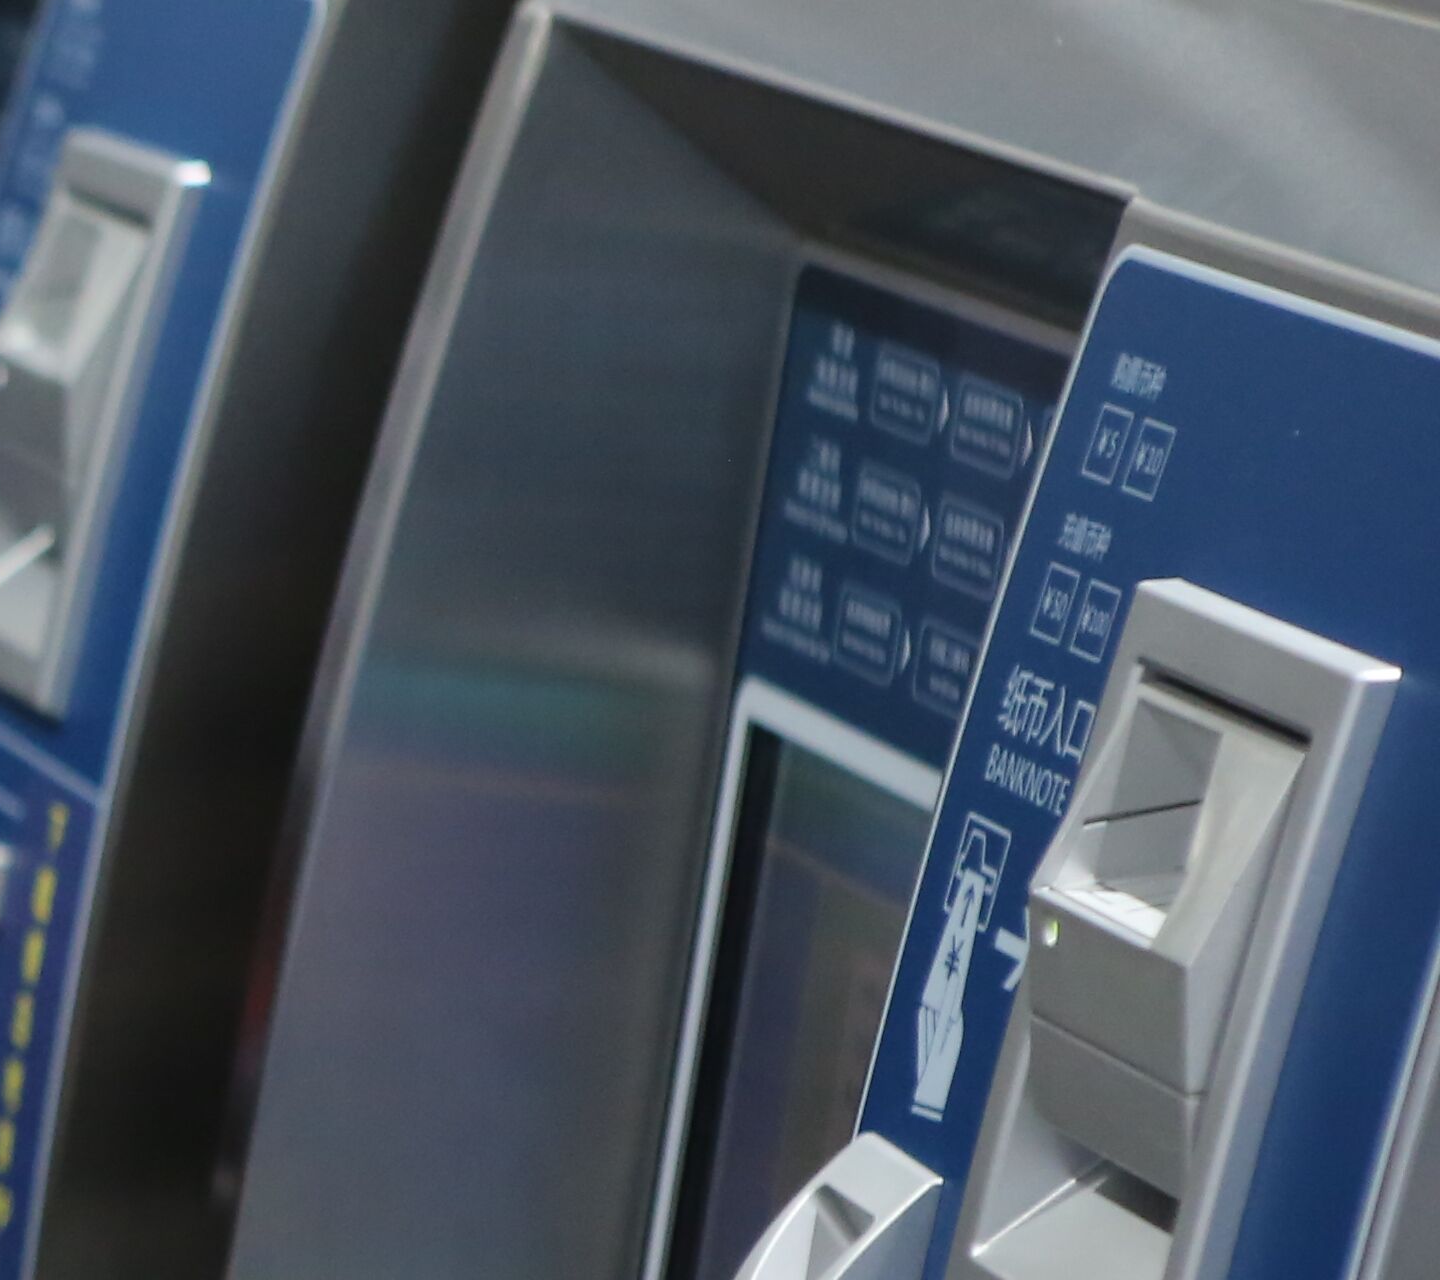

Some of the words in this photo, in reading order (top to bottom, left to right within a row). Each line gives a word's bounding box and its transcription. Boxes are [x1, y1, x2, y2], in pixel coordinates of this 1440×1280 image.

[998, 663, 1097, 763] 纸币入口
[984, 742, 1071, 817] BANKNOTE
